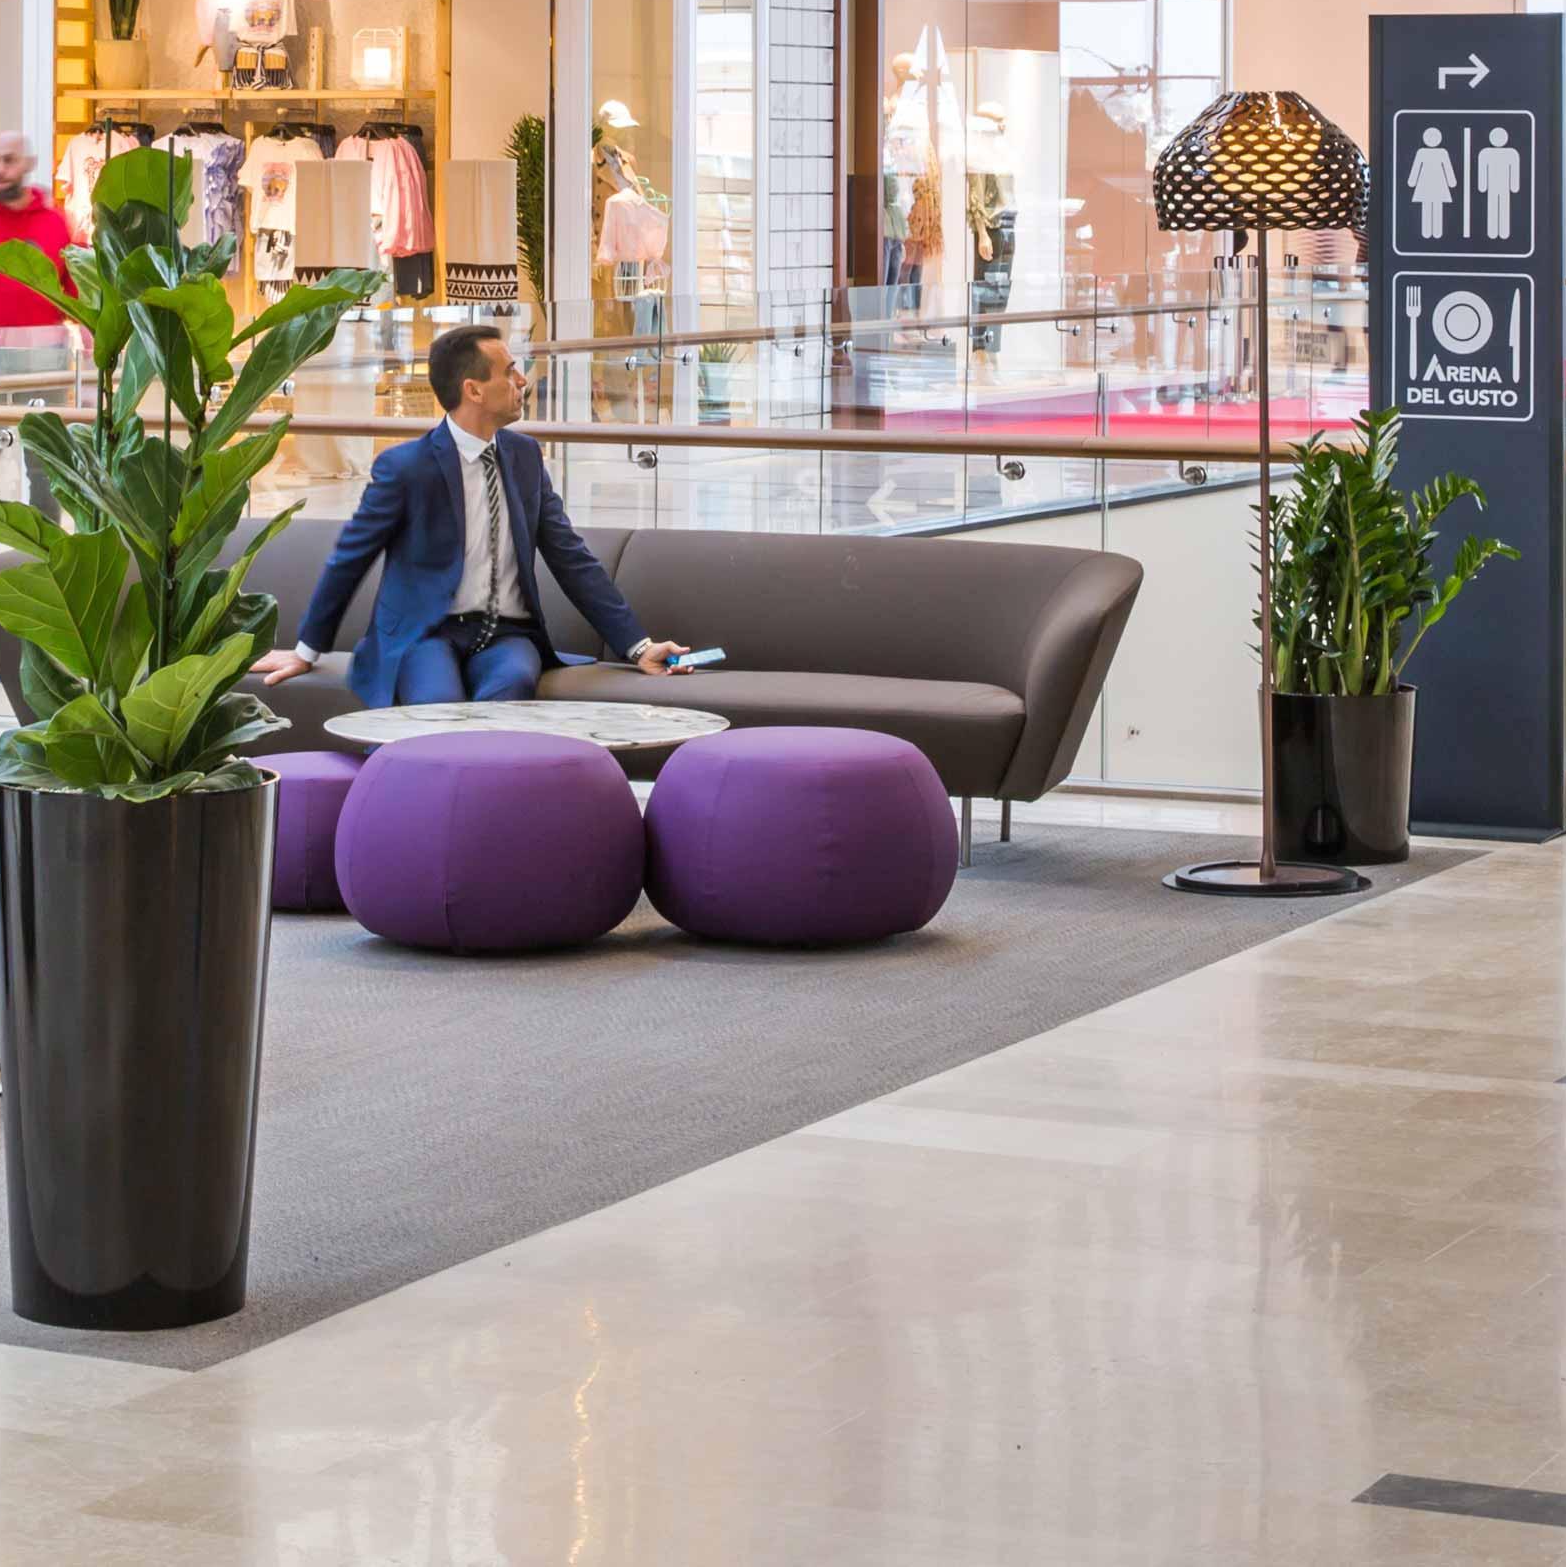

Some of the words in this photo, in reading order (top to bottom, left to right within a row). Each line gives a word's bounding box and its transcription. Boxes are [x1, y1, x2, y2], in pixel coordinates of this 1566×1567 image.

[1422, 354, 1502, 383] ARENA
[1407, 387, 1445, 405] DEL
[1448, 388, 1518, 407] GUSTO
